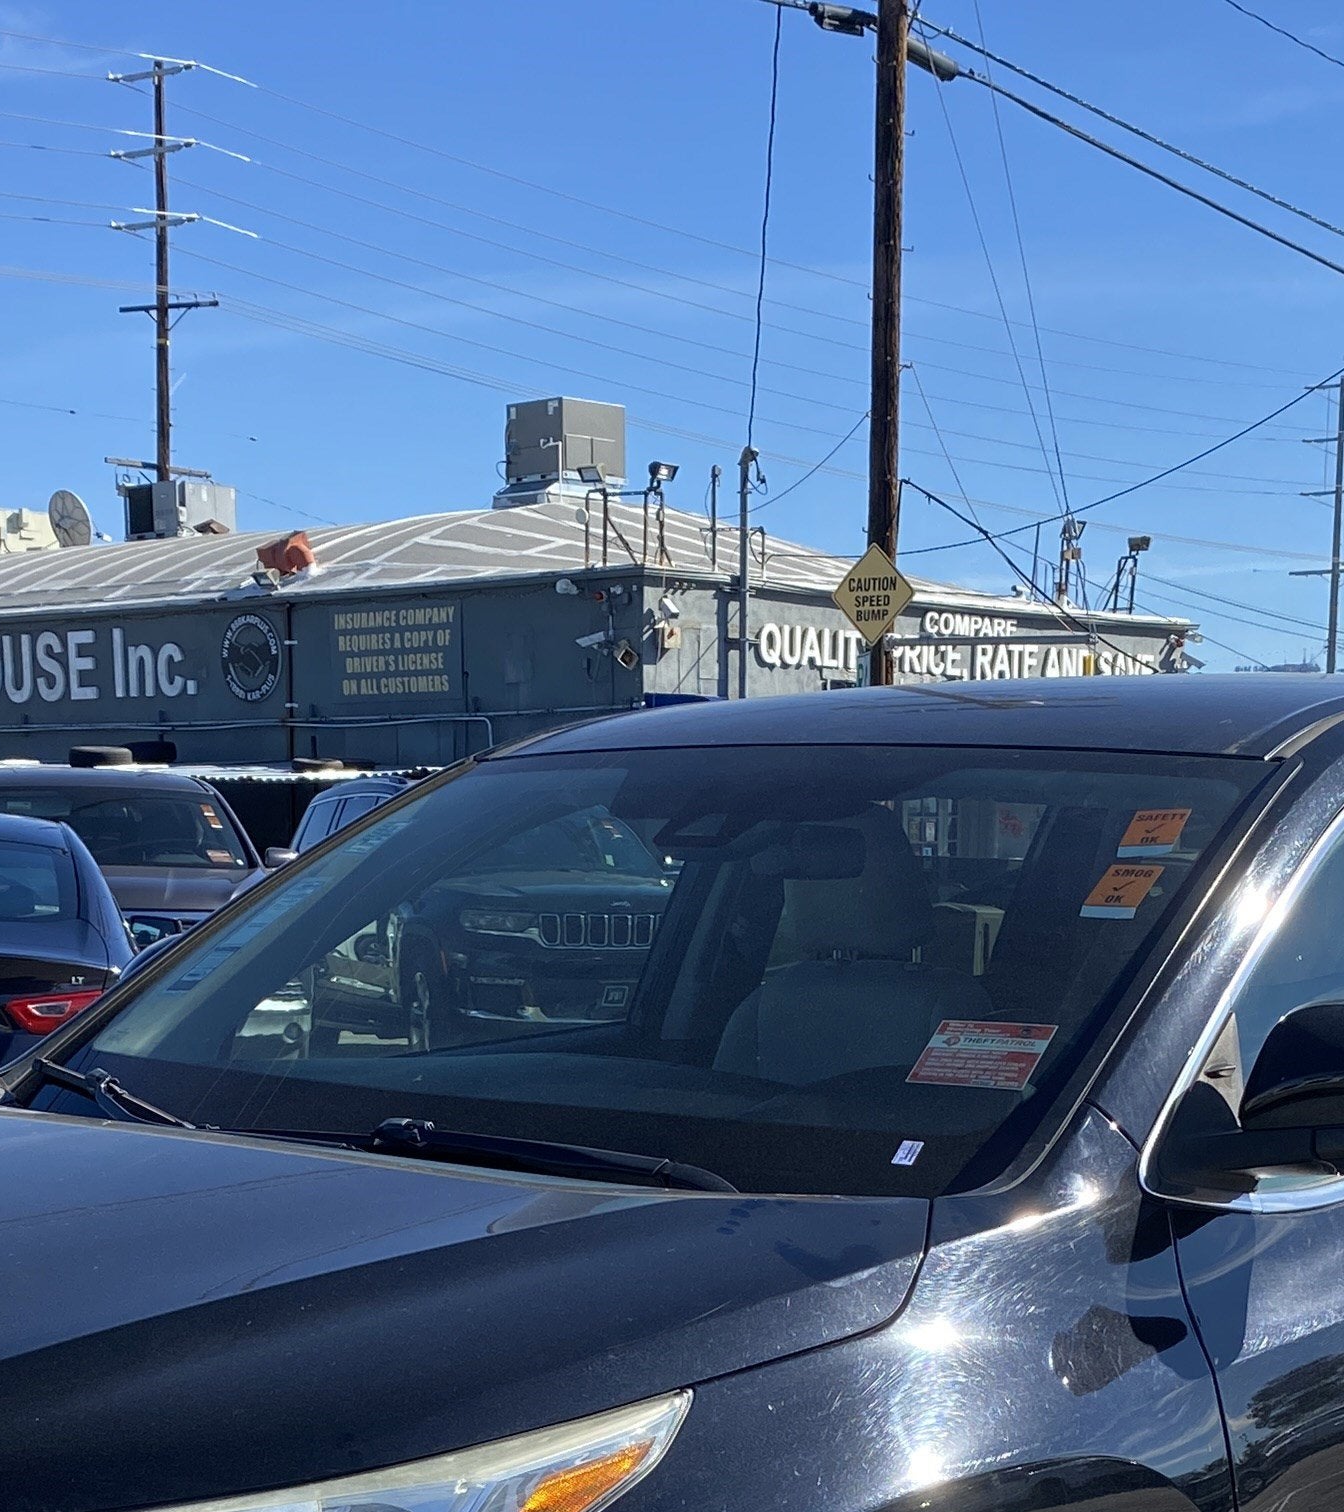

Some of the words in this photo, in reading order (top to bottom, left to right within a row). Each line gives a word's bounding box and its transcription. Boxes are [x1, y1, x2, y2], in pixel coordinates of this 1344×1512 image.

[848, 576, 897, 592] CAUTION
[854, 594, 890, 607] SPEED
[334, 610, 397, 630] INSURANCE
[399, 606, 455, 626] COMPANY
[856, 609, 889, 621] BUMP
[924, 611, 1019, 637] COMPARE
[338, 632, 392, 653] REQUIRES
[393, 632, 403, 649] A
[404, 630, 435, 649] COPY
[436, 629, 451, 647] OF
[760, 622, 866, 669] QUALIT
[112, 627, 199, 698] Inc.
[345, 655, 396, 674] DRIVER'S
[398, 652, 445, 671] LICENSE
[342, 679, 359, 696] ON
[360, 677, 379, 696] ALL
[380, 674, 450, 695] CUSTOMERS
[1136, 812, 1187, 822] SAFETY
[1140, 835, 1160, 844] OK
[1111, 868, 1155, 878] SMOG
[1104, 894, 1124, 904] OK
[71, 976, 86, 985] LT
